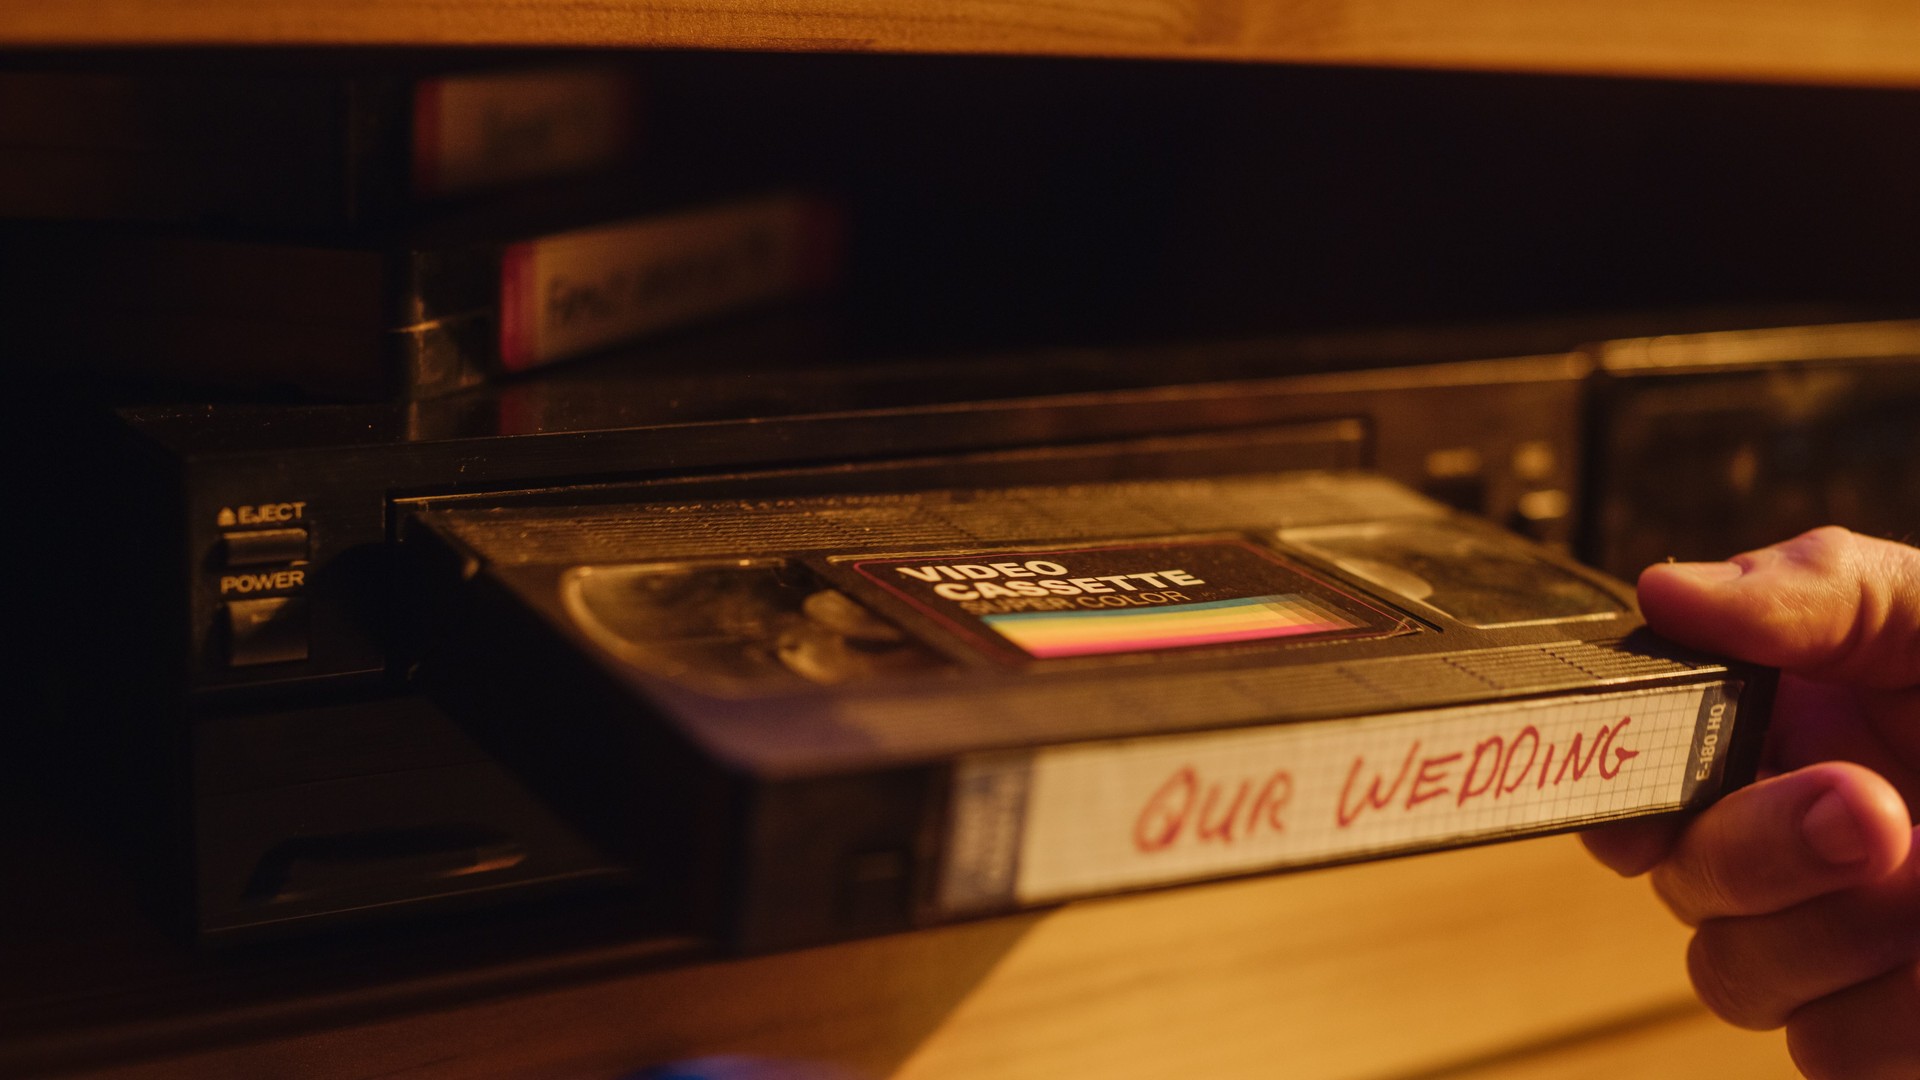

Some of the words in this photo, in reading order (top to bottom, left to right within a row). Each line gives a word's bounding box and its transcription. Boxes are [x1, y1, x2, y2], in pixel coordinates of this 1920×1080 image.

[238, 502, 306, 524] EJECT
[220, 570, 304, 593] POWER
[896, 560, 1068, 582] VIDEO
[933, 569, 1206, 601] CASSETTE
[1076, 591, 1191, 609] COLOR
[1695, 734, 1718, 781] E-180
[1707, 702, 1726, 730] HQ
[1132, 765, 1293, 852] OUR
[1336, 716, 1639, 828] WEDDING
